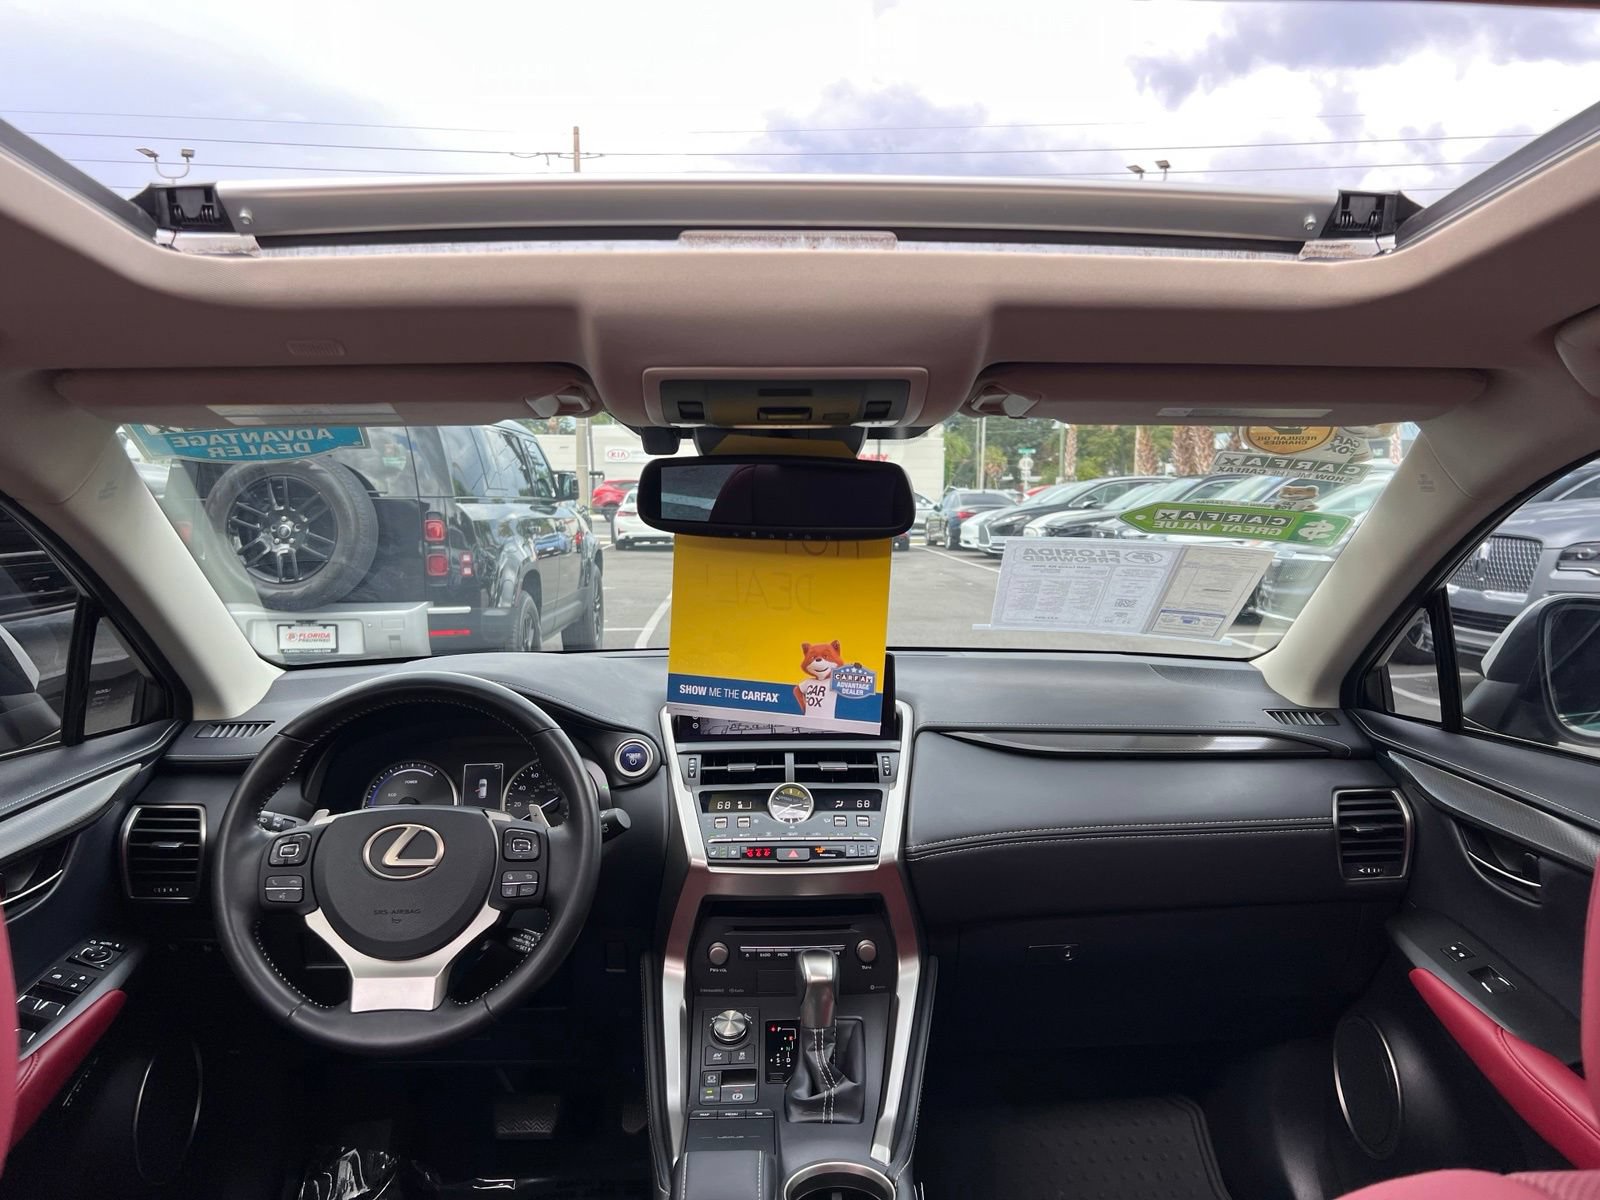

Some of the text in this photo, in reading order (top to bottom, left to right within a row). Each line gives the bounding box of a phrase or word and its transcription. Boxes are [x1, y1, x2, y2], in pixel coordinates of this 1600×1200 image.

[835, 674, 873, 683] CARFAX
[836, 681, 870, 690] ADVANTAGE
[680, 684, 778, 703] SHOW ME THE CARFAX
[806, 697, 823, 707] OX
[717, 801, 731, 810] 68
[856, 800, 870, 808] 68
